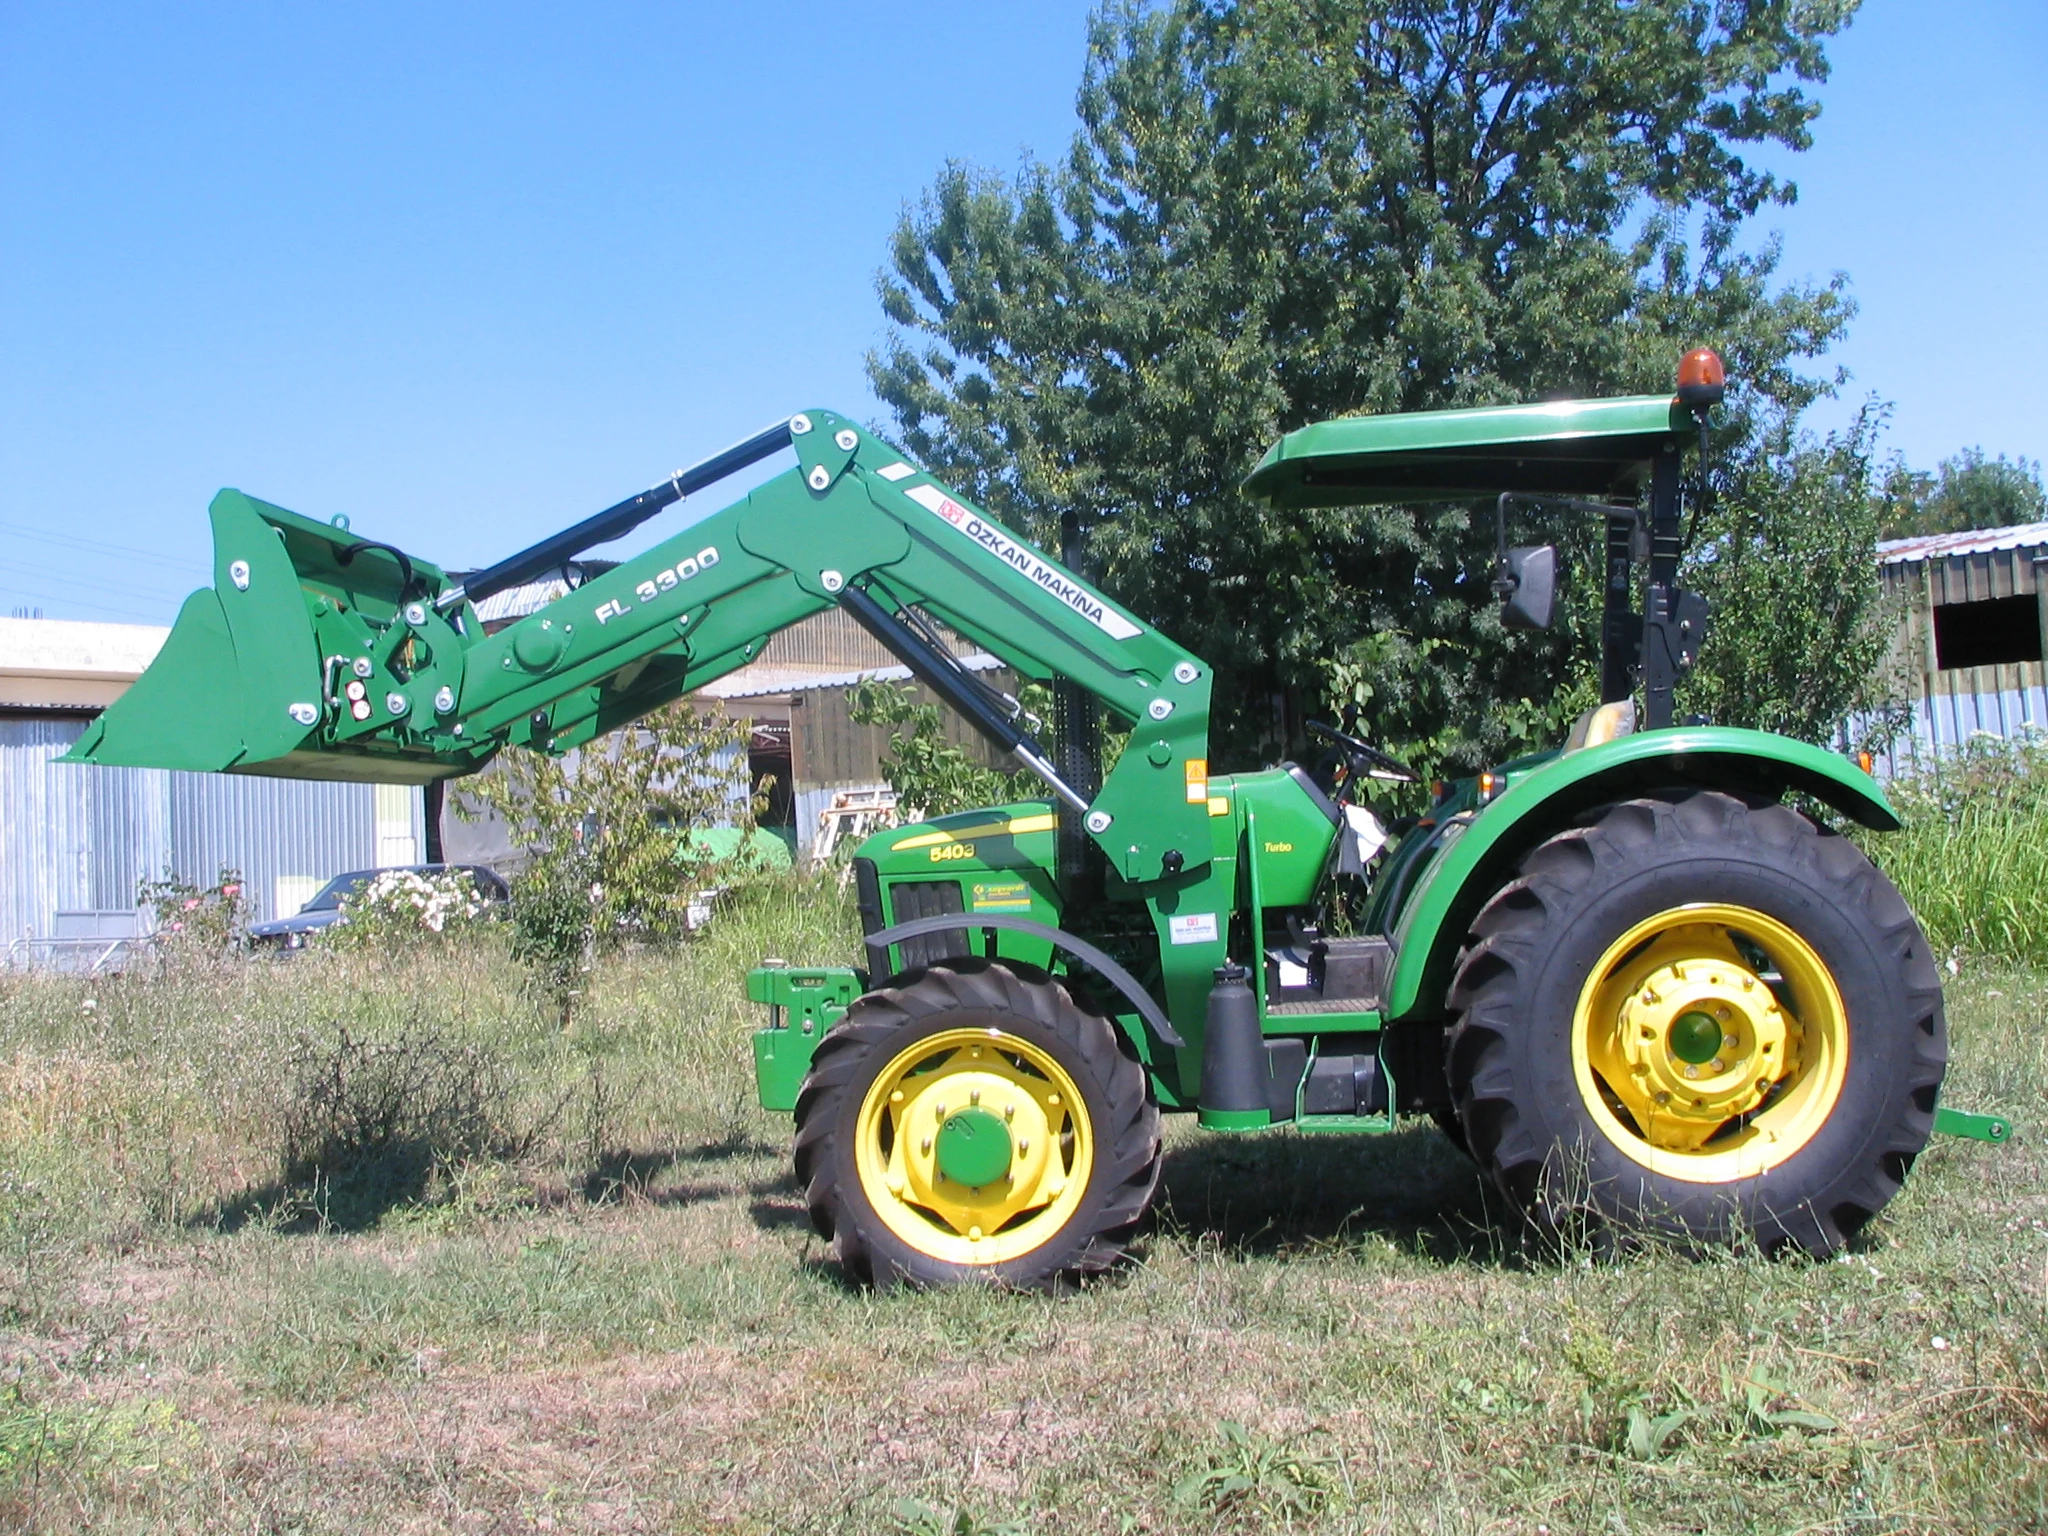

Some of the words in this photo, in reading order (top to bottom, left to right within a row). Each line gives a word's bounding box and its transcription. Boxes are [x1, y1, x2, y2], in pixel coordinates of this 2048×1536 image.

[594, 599, 633, 627] FL
[635, 546, 720, 603] 3300
[966, 519, 1032, 572] ÖZKAN
[1031, 565, 1103, 624] MAKİNA
[929, 843, 976, 862] 5403
[1264, 842, 1293, 853] Turbo
